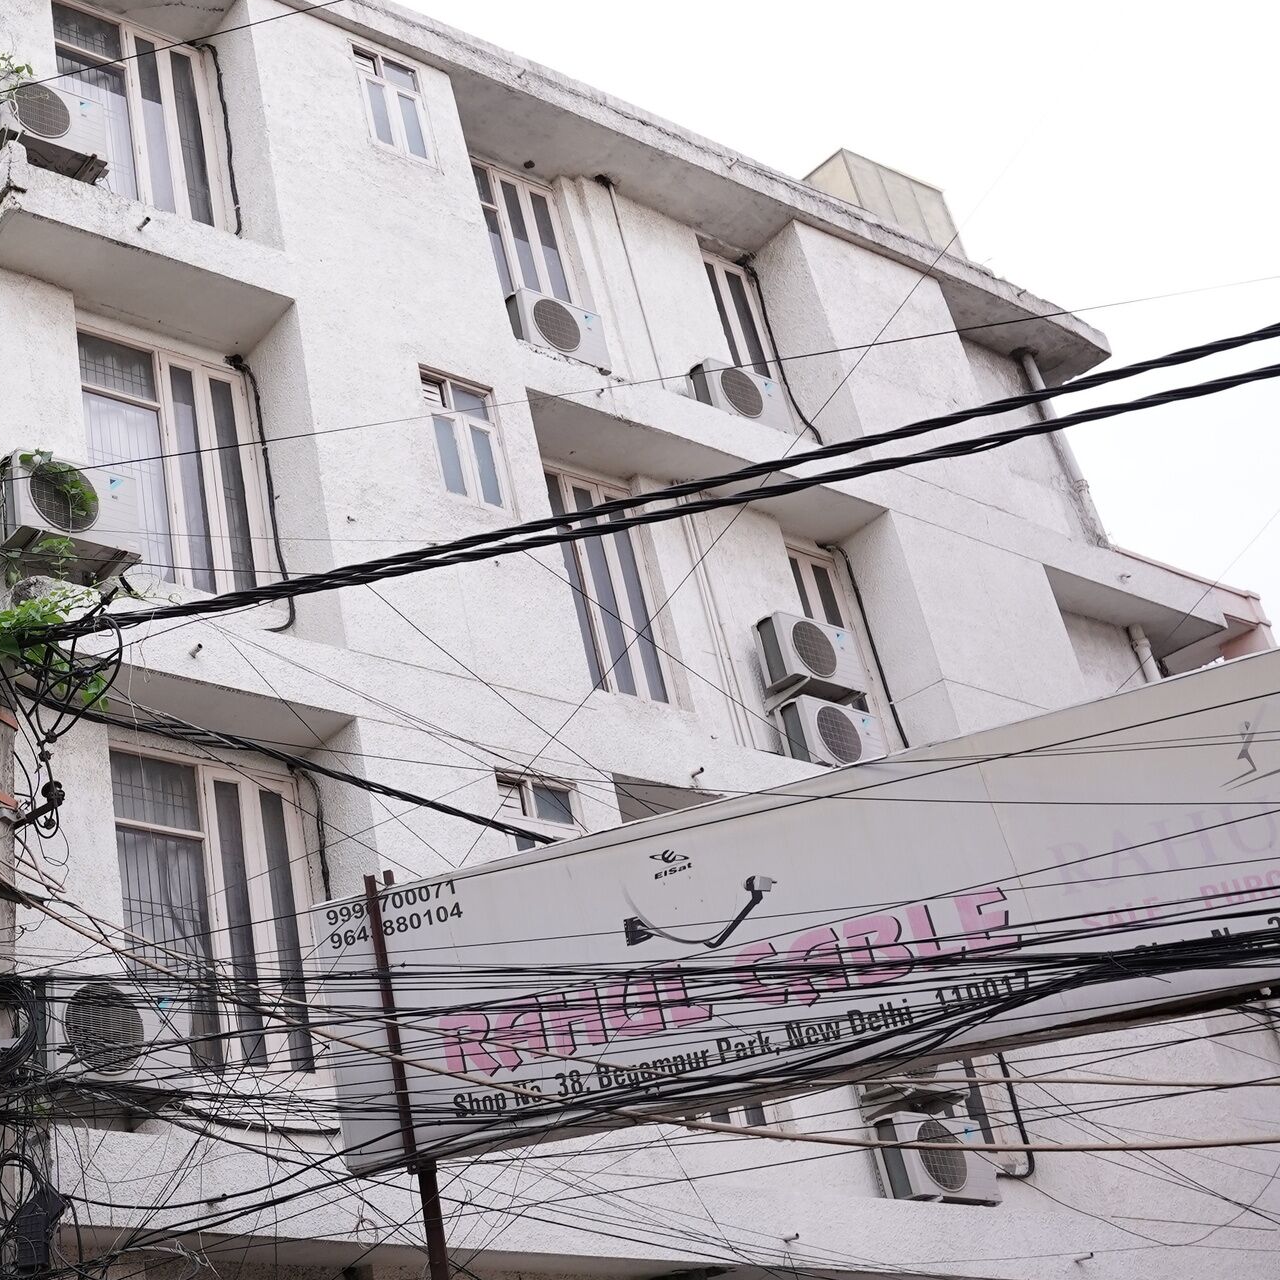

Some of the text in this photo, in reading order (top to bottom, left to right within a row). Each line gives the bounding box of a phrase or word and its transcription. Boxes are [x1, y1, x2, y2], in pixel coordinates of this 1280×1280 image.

[654, 862, 692, 880] ElSat
[326, 879, 457, 926] 999700071
[329, 901, 464, 950] 964880104
[438, 965, 712, 1076] RAHUL
[734, 887, 1022, 1008] CABLE
[453, 1092, 507, 1118] Shop
[598, 1043, 709, 1091] Begampur
[783, 1018, 842, 1052] New
[847, 998, 915, 1034] Delhi
